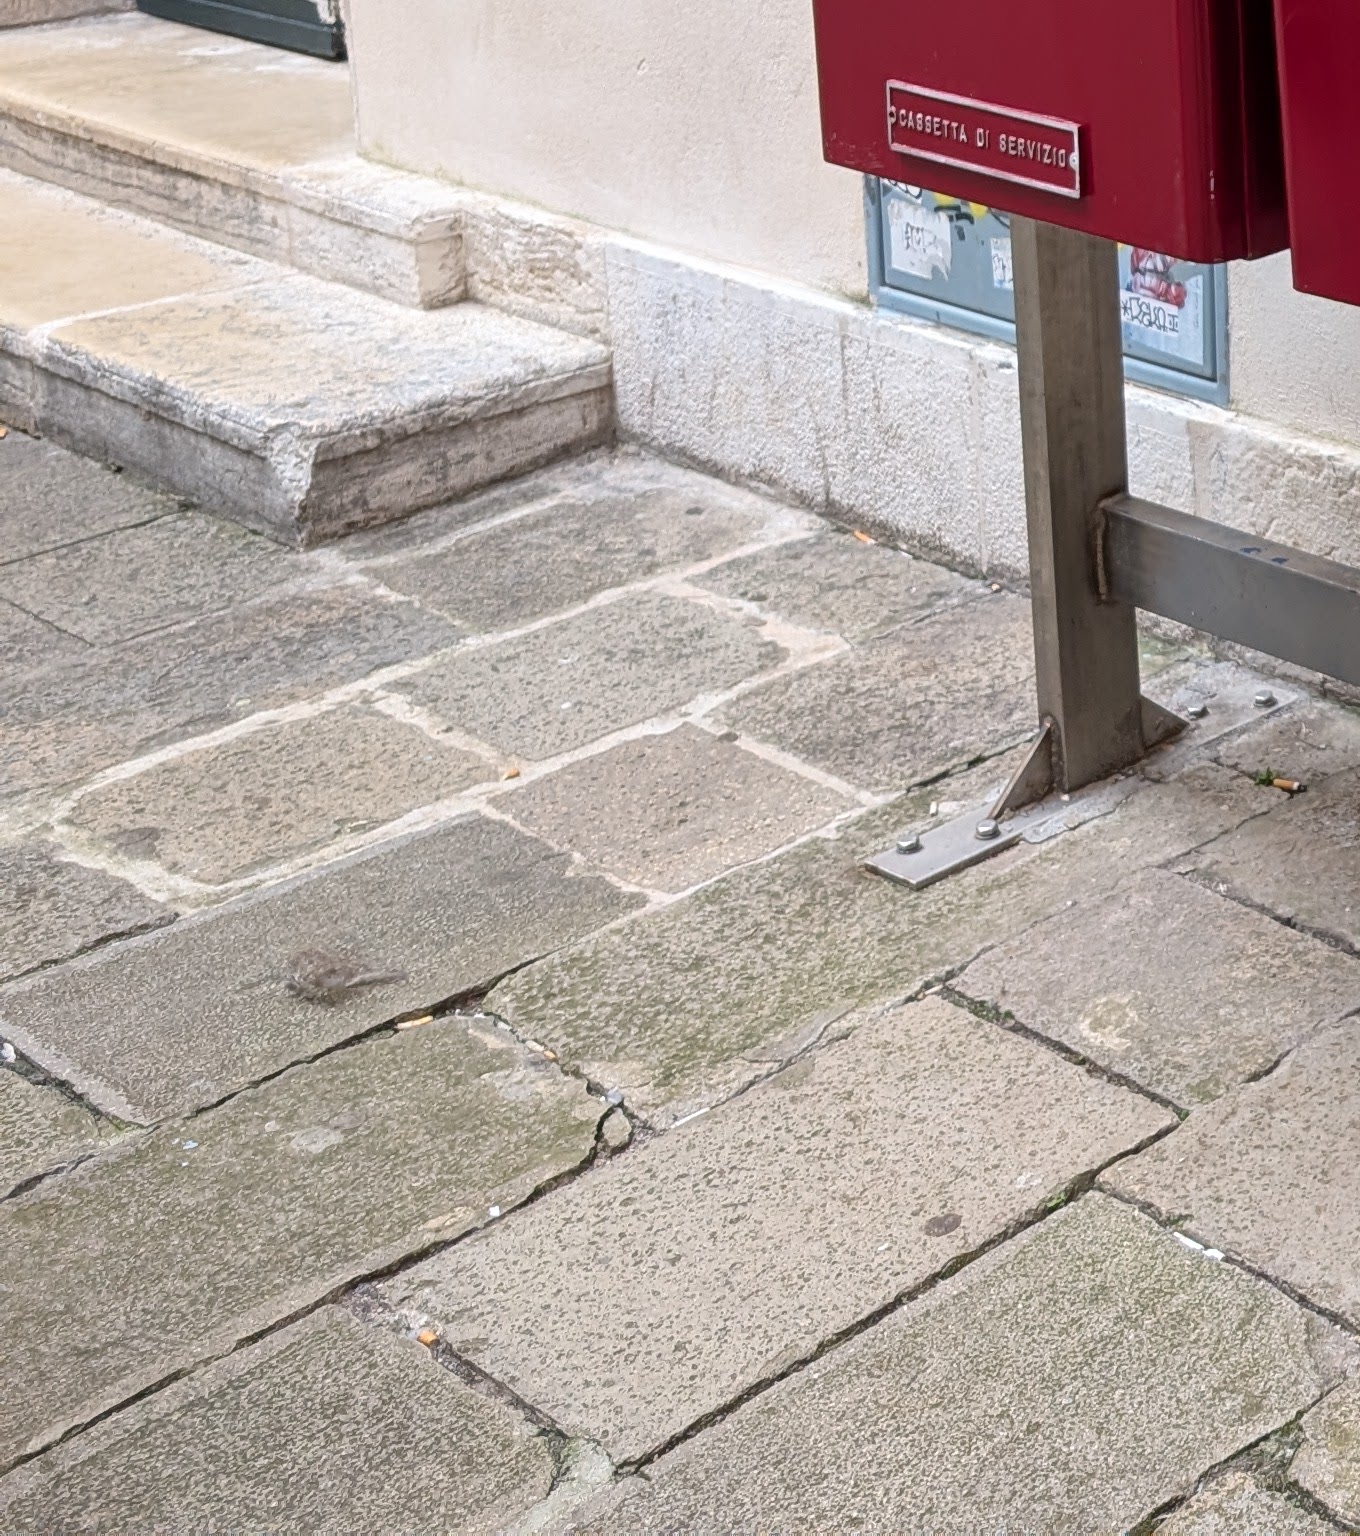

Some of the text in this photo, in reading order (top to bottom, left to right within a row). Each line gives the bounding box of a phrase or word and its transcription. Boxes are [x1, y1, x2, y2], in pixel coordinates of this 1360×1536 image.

[899, 109, 1066, 168] CASSETTA DI SERVIZIO
